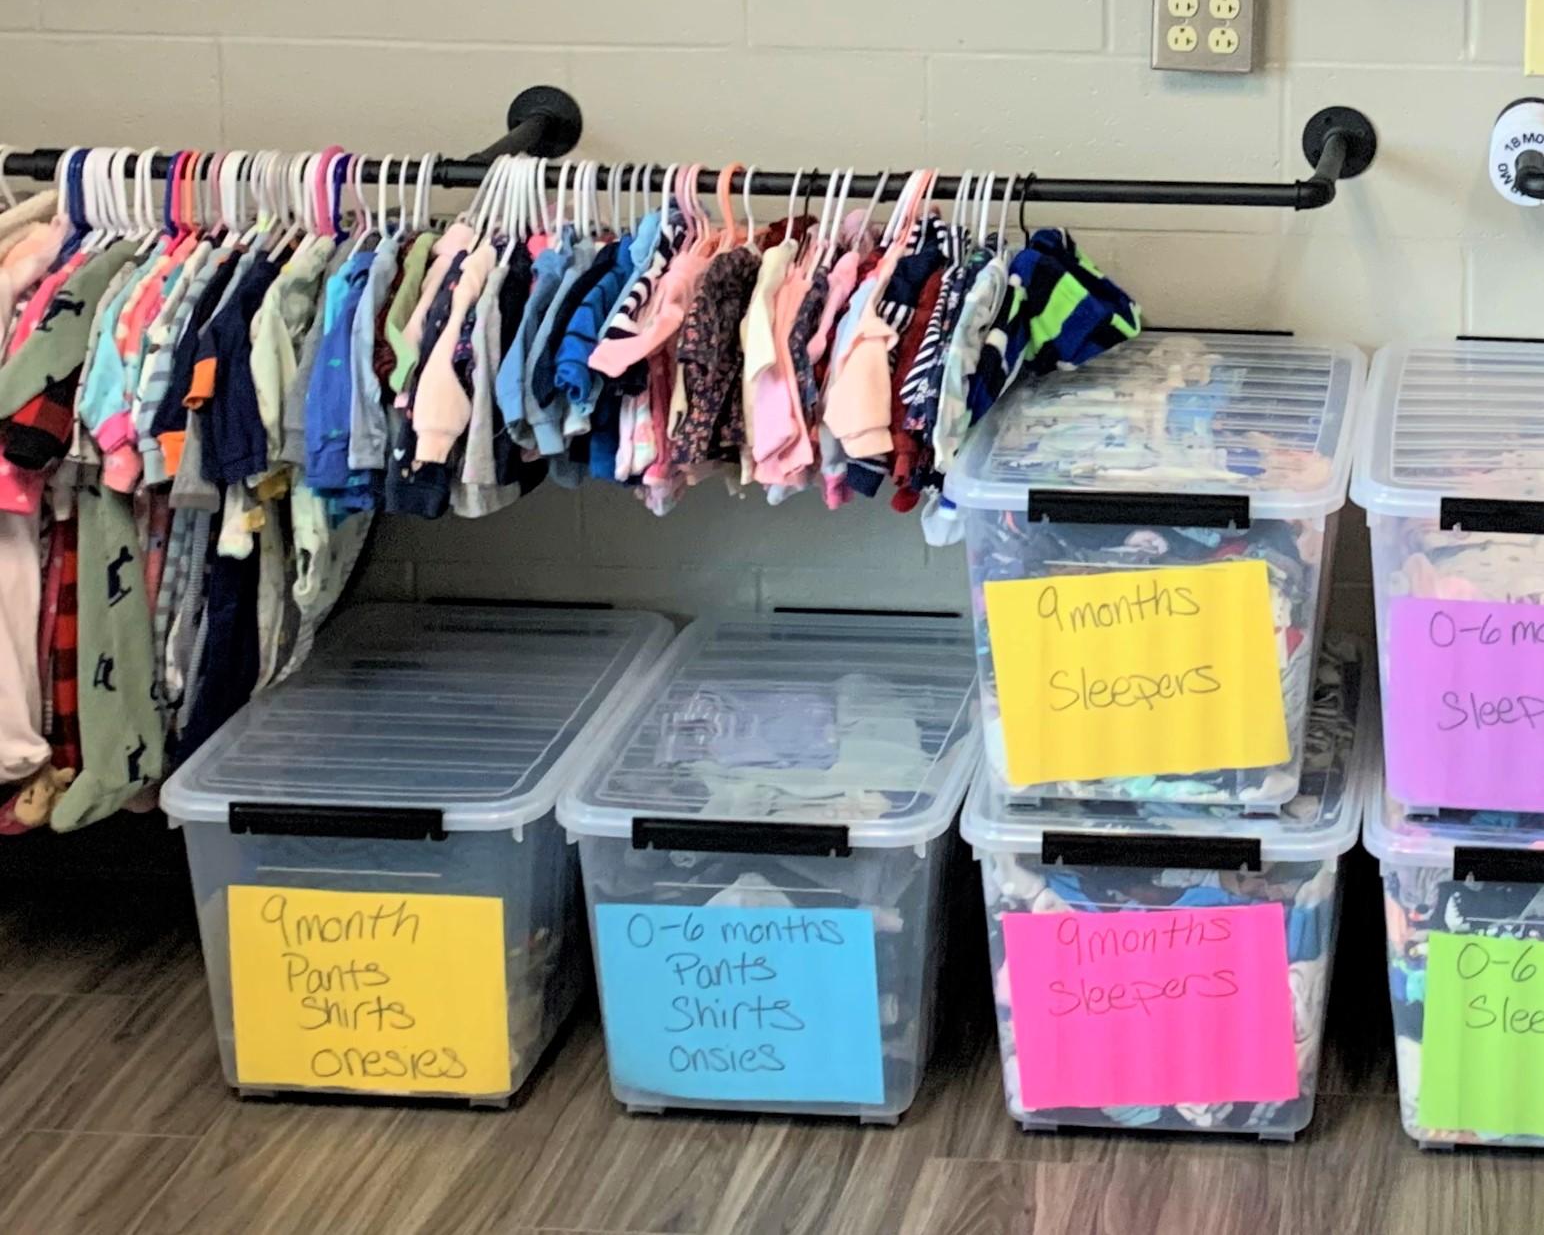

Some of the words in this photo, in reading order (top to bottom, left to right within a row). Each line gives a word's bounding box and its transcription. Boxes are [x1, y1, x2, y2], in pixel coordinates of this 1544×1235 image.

[1430, 611, 1500, 647] 0-6
[1050, 665, 1221, 711] Sleepers
[627, 913, 704, 947] 0-6
[722, 915, 844, 945] months
[281, 952, 391, 993] Pants
[665, 951, 777, 989] Pants
[1457, 942, 1537, 983] 0-6
[1049, 969, 1239, 1017] Sleepers
[299, 995, 415, 1031] Shirts
[664, 995, 805, 1032] Shirts
